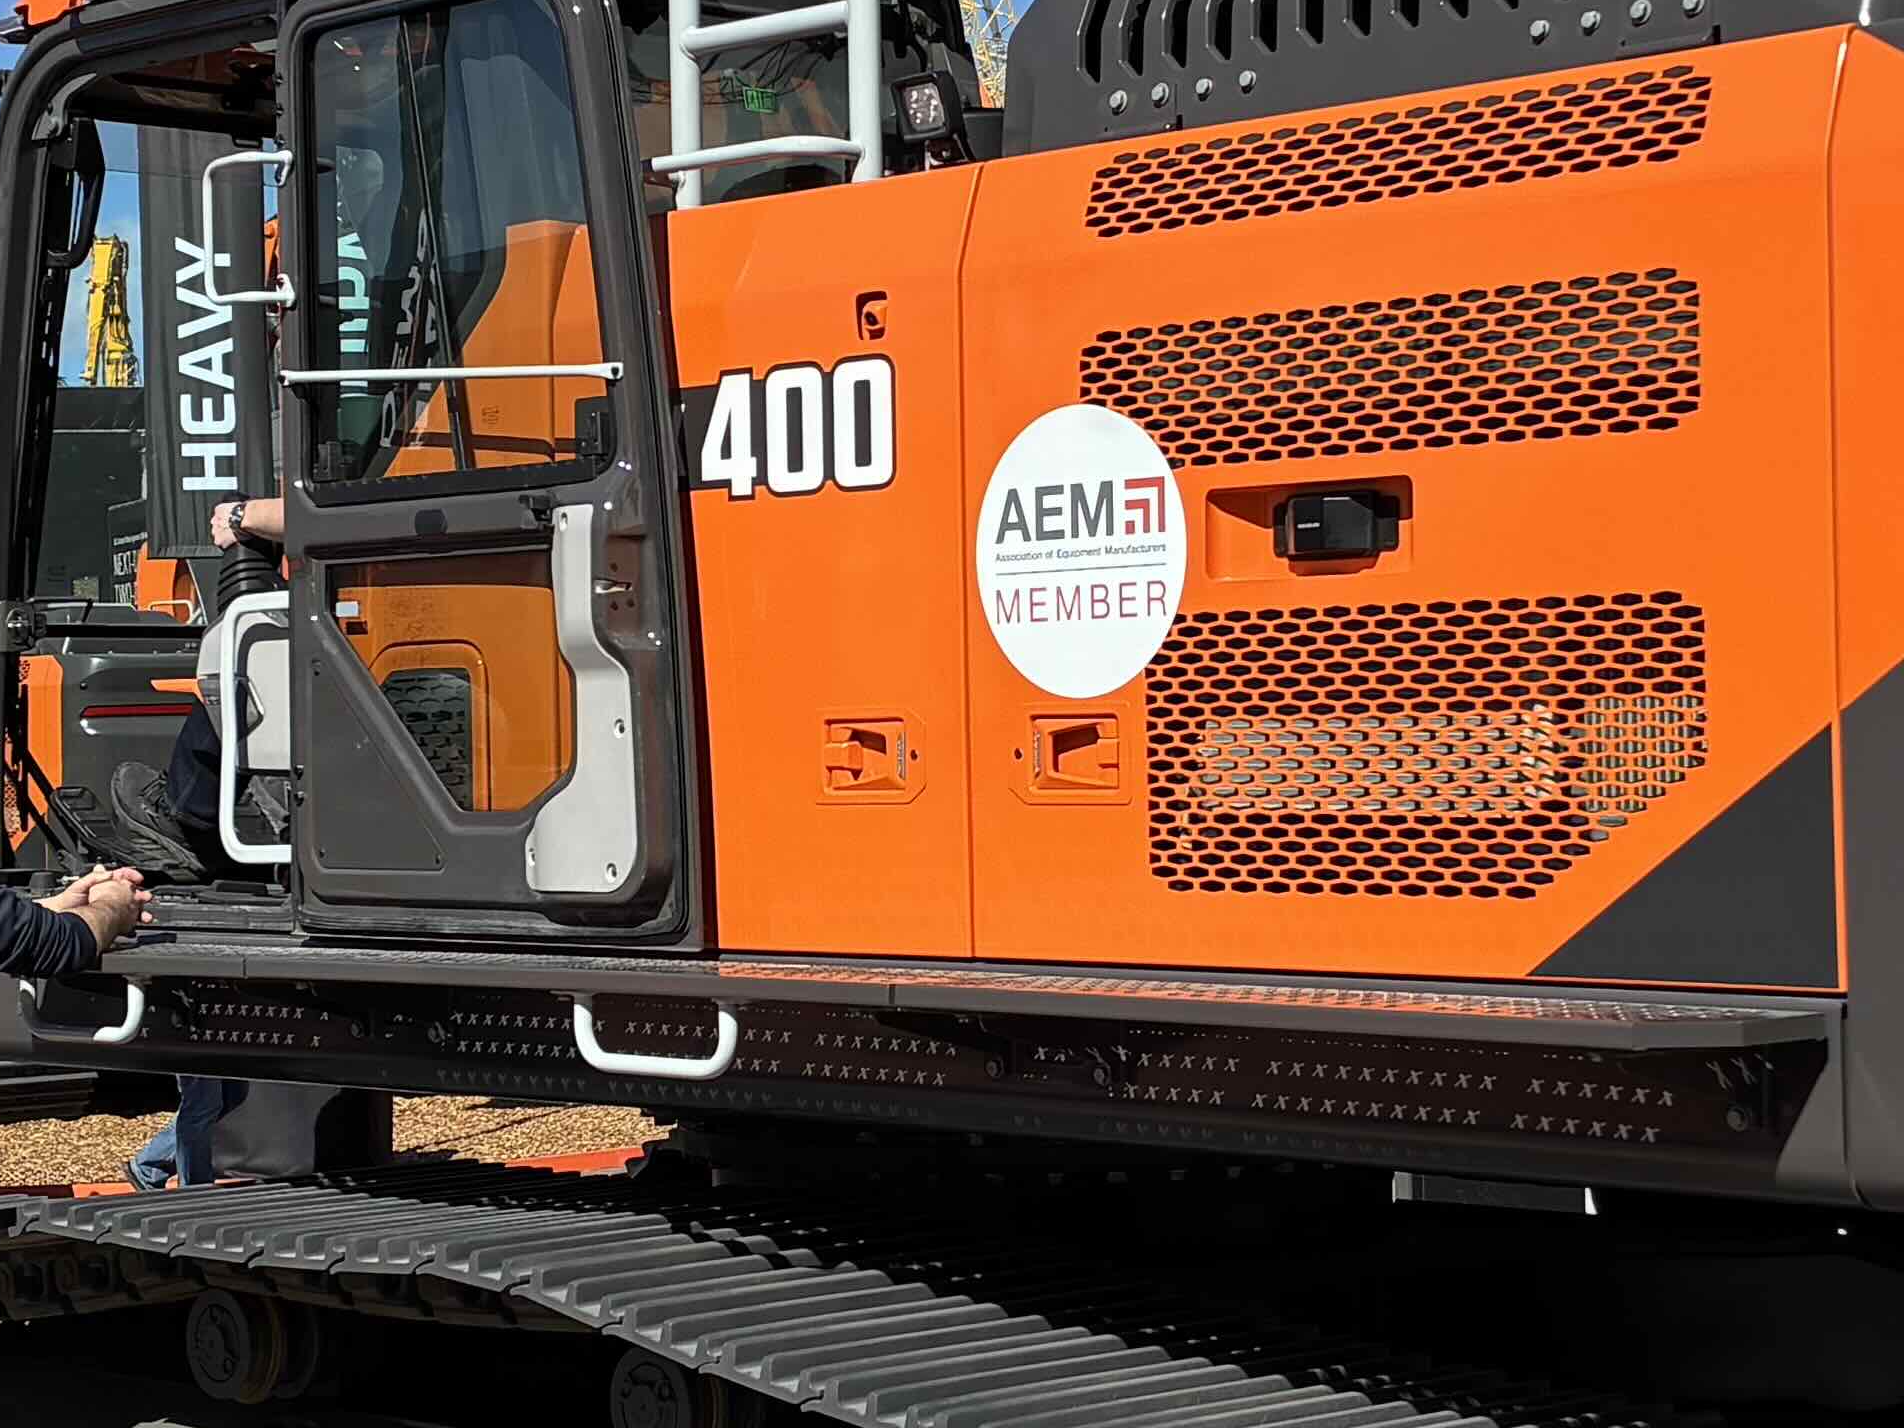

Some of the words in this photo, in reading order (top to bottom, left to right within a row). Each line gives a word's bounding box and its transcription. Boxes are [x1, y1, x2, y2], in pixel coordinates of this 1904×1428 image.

[174, 236, 238, 491] HEAVY
[700, 357, 895, 497] 400
[994, 479, 1114, 545] AEM
[995, 552, 1044, 562] Association
[1045, 549, 1054, 559] of
[1056, 547, 1102, 559] Equipment
[1104, 543, 1167, 556] Manufacturers
[995, 579, 1167, 625] MEMBER
